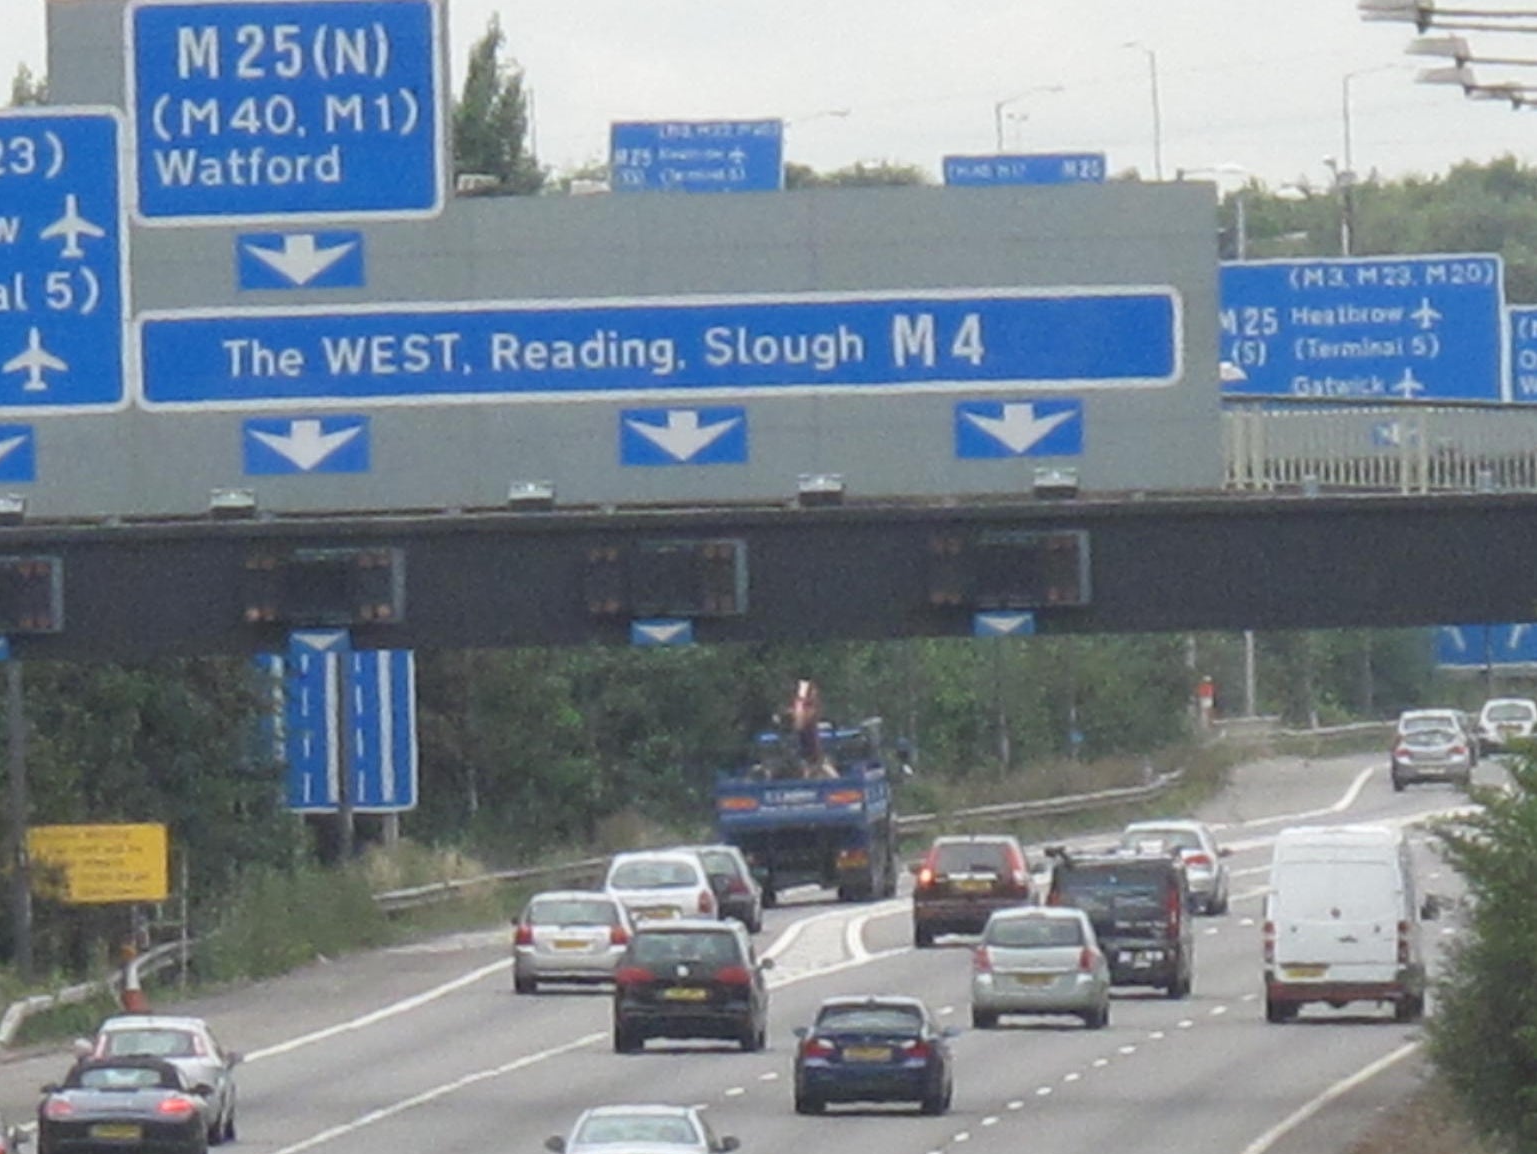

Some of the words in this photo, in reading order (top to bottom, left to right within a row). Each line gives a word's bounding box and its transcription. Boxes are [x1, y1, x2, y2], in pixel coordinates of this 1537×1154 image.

[152, 95, 307, 140] (M40,
[325, 88, 418, 135] M1)
[154, 146, 341, 187] Watford
[46, 267, 100, 315] 5)
[1291, 305, 1404, 326] Heathrow
[223, 340, 304, 377] The
[491, 330, 686, 376] Reading,
[704, 324, 864, 372] Slough
[892, 314, 985, 368] M4
[1232, 339, 1268, 367] (S)
[1295, 338, 1404, 361] (Terminal
[1412, 332, 1441, 360] 5)
